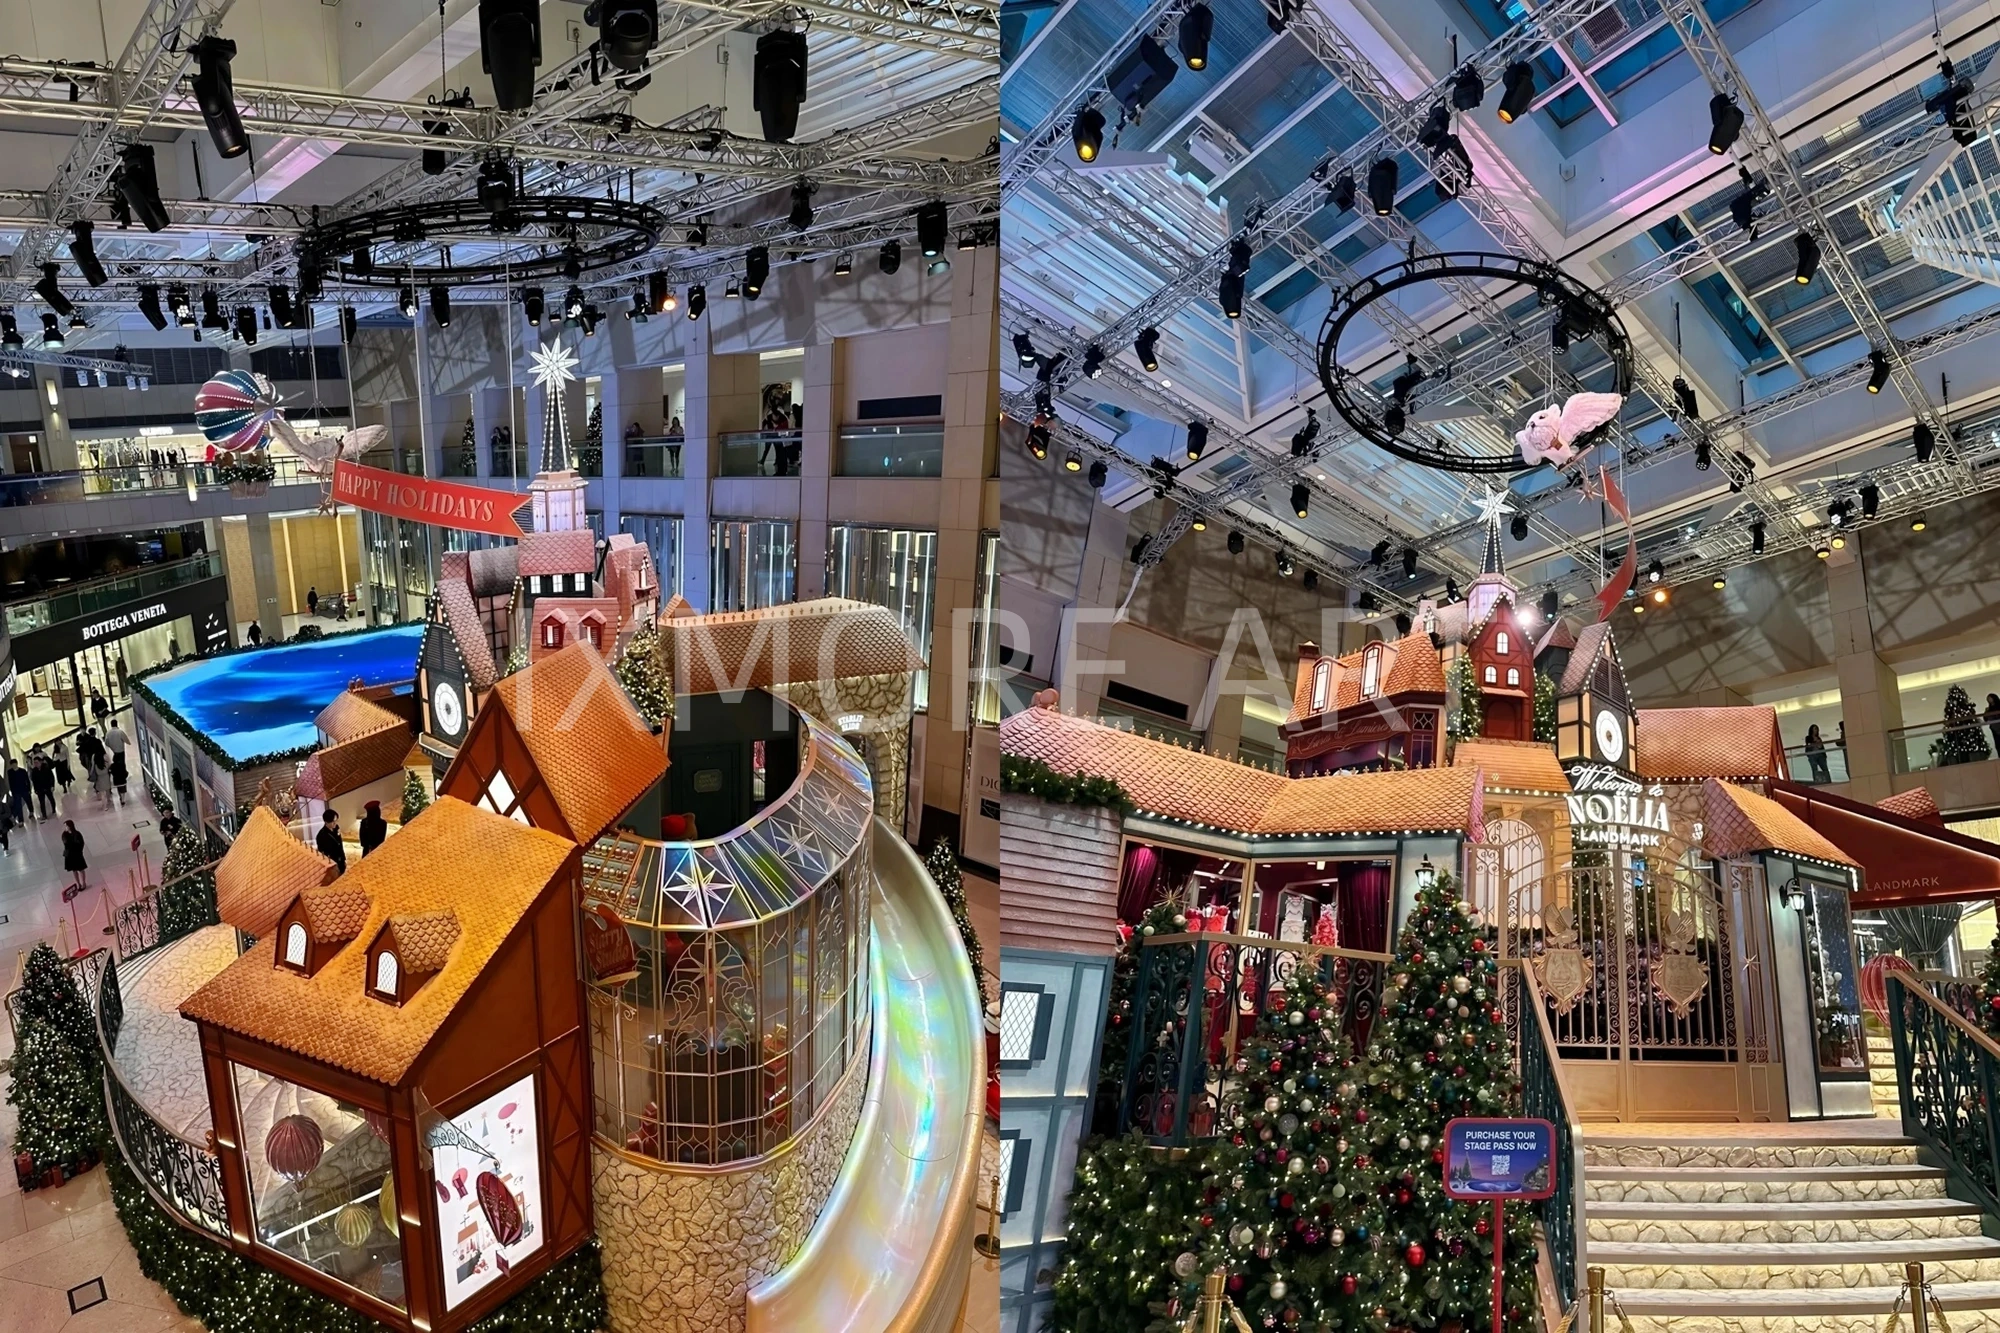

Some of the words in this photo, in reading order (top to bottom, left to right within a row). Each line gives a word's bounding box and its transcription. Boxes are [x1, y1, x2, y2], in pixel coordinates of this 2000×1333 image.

[338, 472, 383, 501] HAPPY
[387, 483, 495, 522] HOLIDAYS
[82, 615, 130, 640] BOTTEGA
[130, 603, 167, 624] VENETA
[1564, 765, 1644, 795] Welcome
[1649, 783, 1664, 797] to
[1580, 827, 1660, 846] LANDMARK
[1865, 876, 1940, 892] LANDMARK
[1465, 1131, 1511, 1140] PURCHASE
[1512, 1131, 1536, 1140] YOUR
[1464, 1141, 1492, 1151] STAGE
[1493, 1141, 1515, 1151] PASS
[1517, 1141, 1537, 1151] NOW
